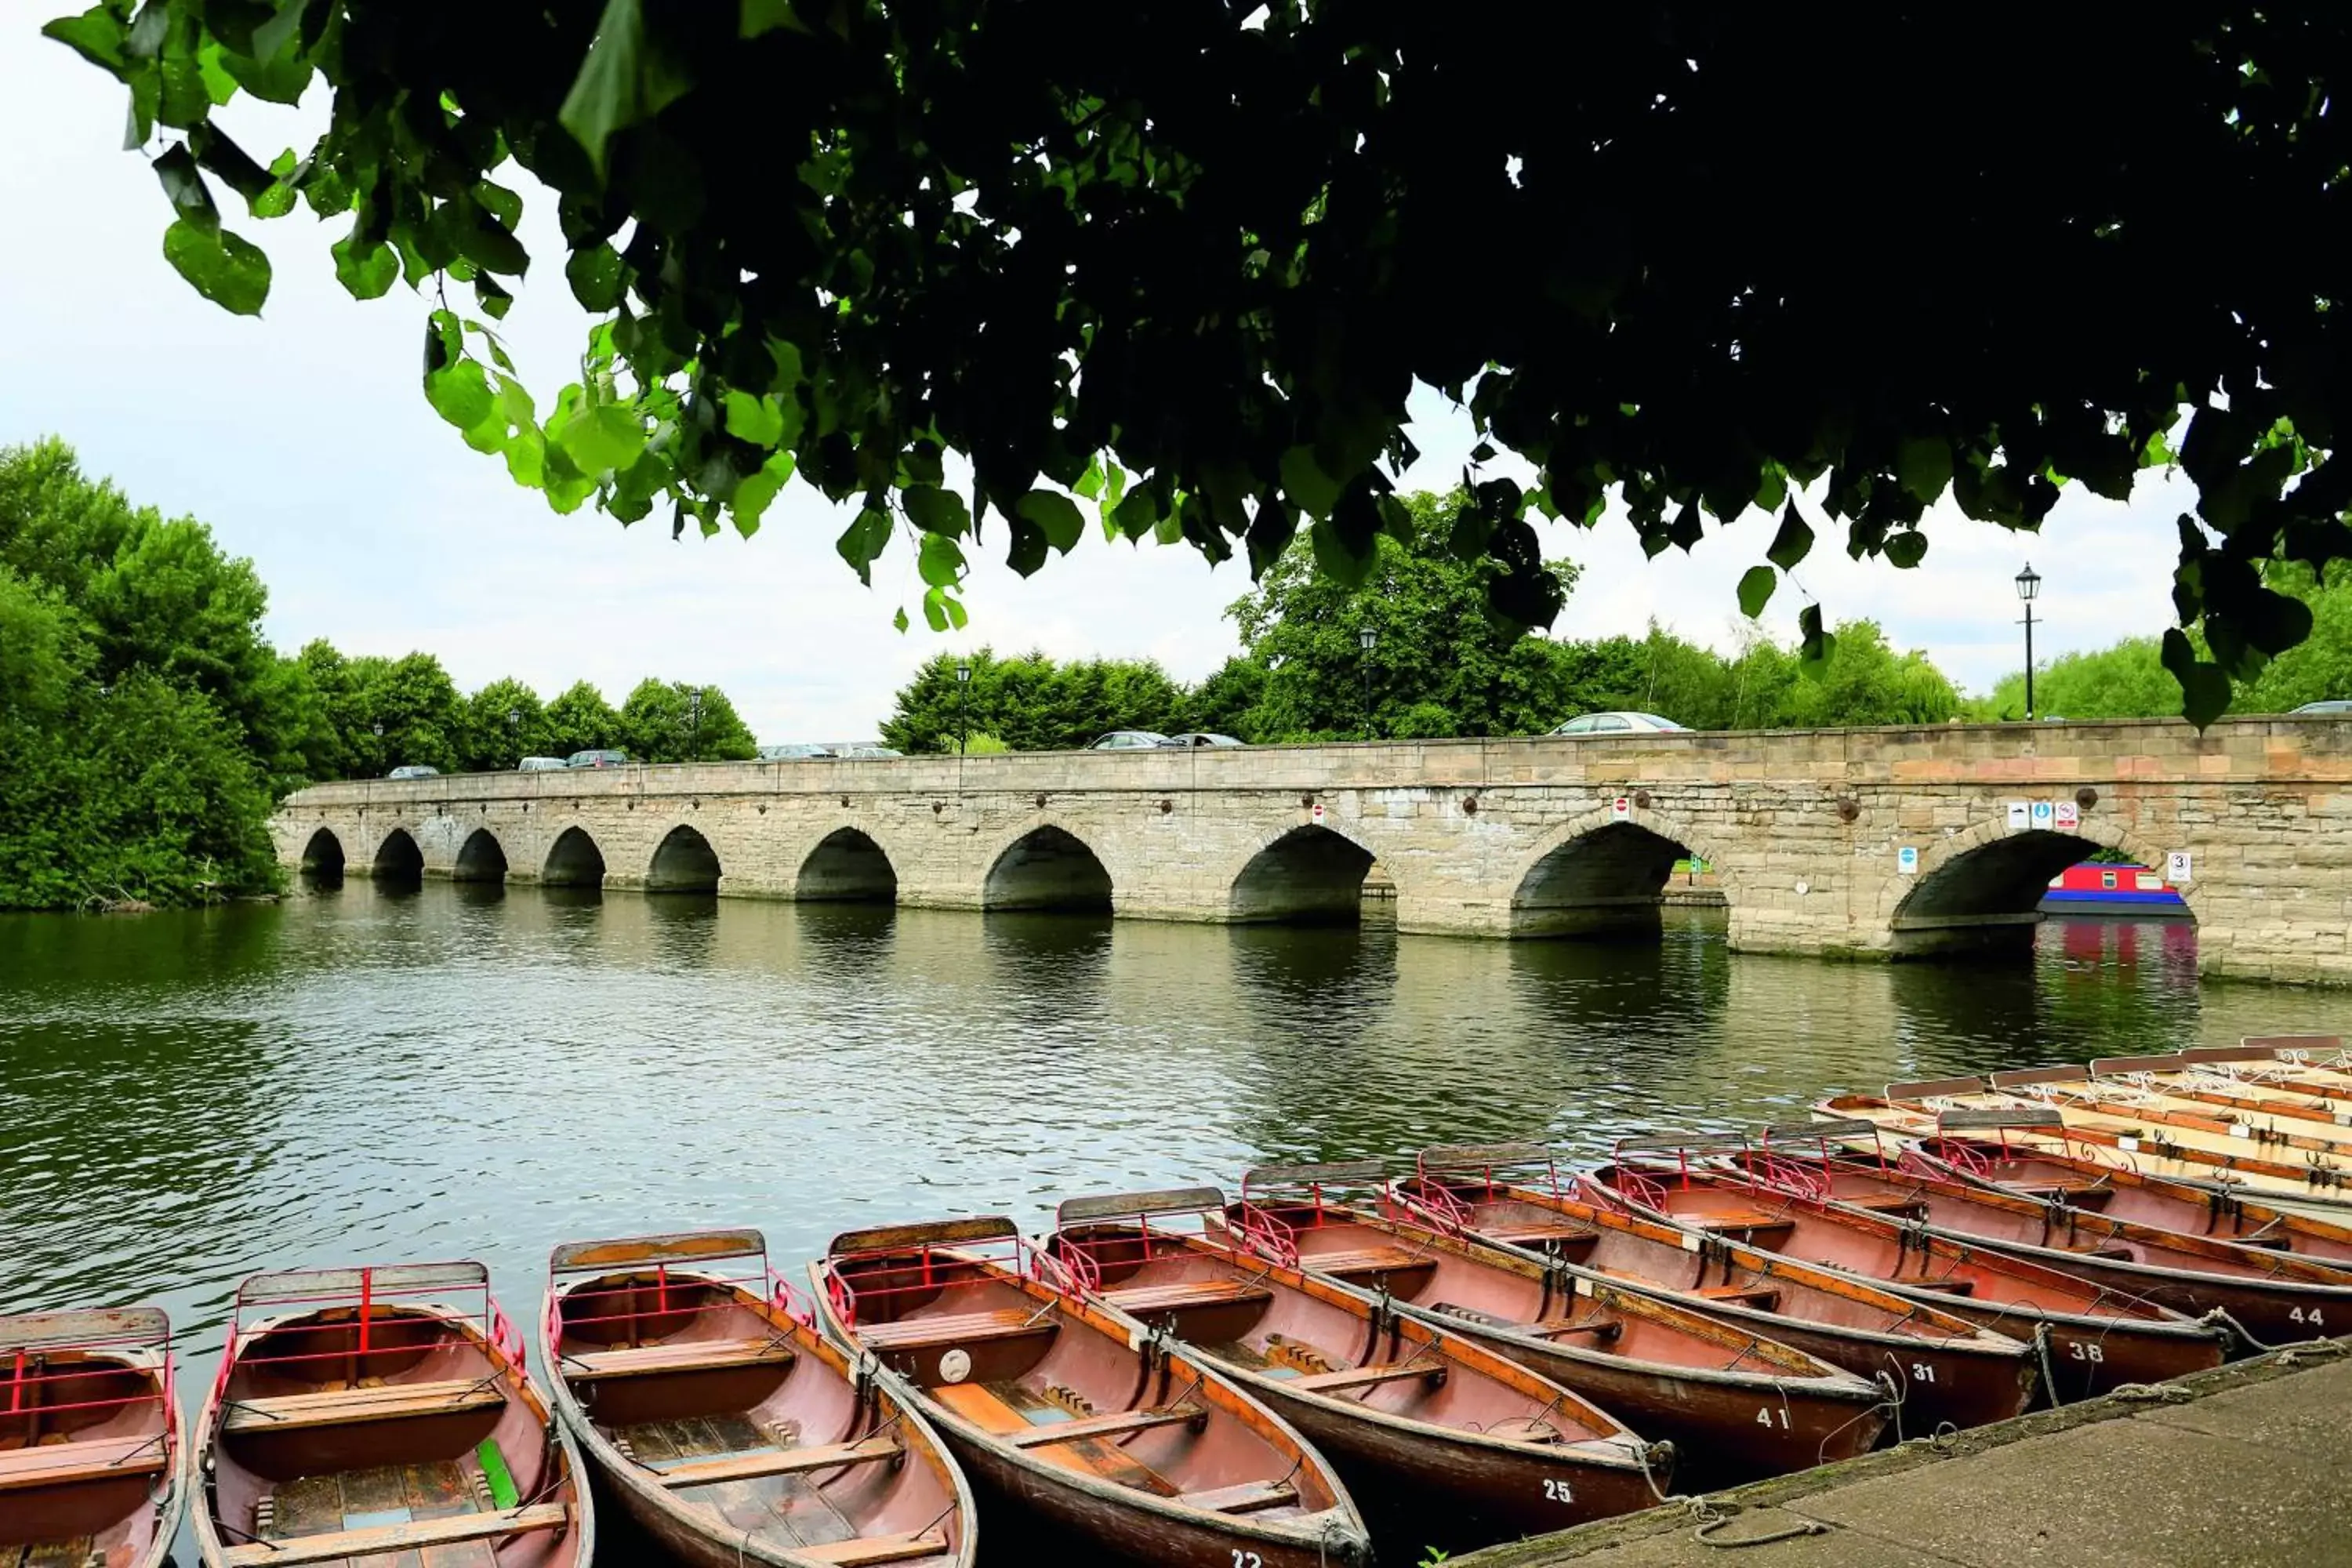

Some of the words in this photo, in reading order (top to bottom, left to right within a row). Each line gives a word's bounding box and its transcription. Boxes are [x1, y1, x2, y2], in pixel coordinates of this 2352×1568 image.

[2175, 855, 2183, 868] 3
[2289, 1306, 2325, 1327] 44
[2069, 1341, 2103, 1363] 38
[1912, 1363, 1935, 1382] 31
[1756, 1407, 1789, 1429] 41
[1543, 1479, 1571, 1503] 25
